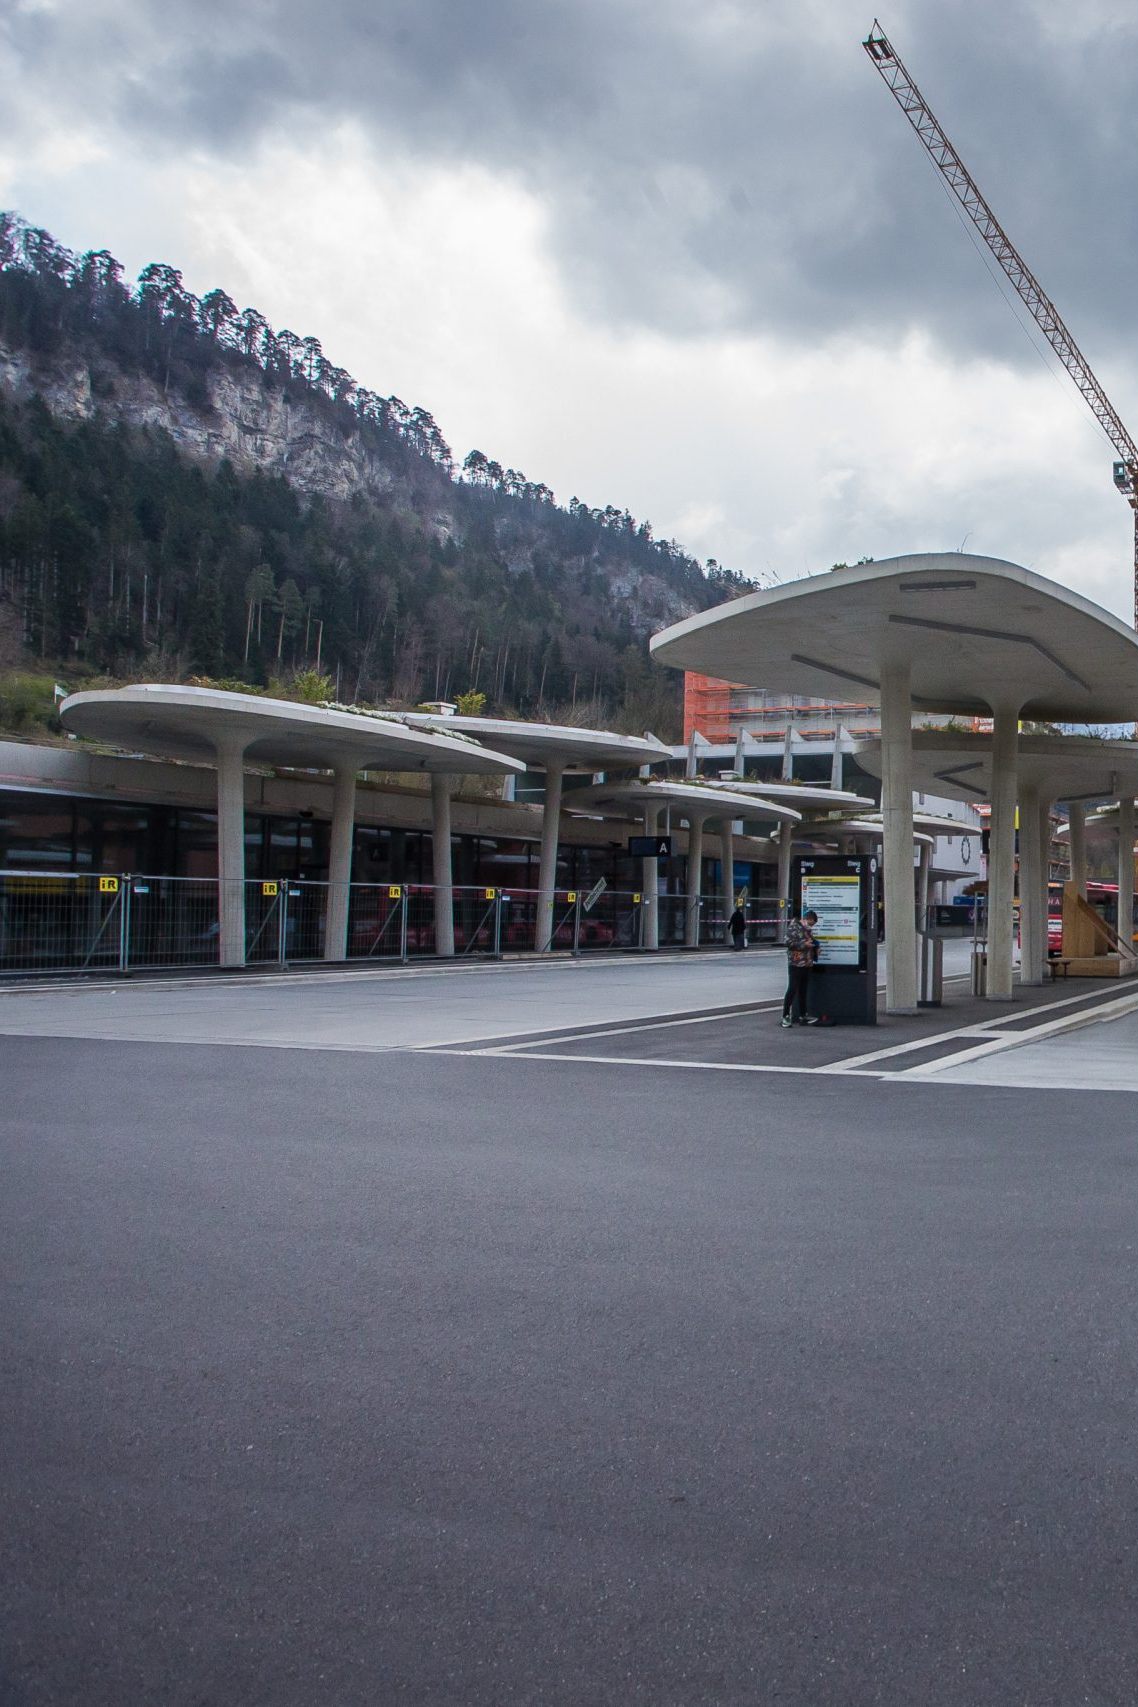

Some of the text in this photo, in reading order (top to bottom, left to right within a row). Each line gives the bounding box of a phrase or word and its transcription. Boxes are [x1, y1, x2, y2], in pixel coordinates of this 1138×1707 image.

[660, 842, 668, 853] A
[101, 879, 117, 890] iR
[264, 884, 276, 894] iR
